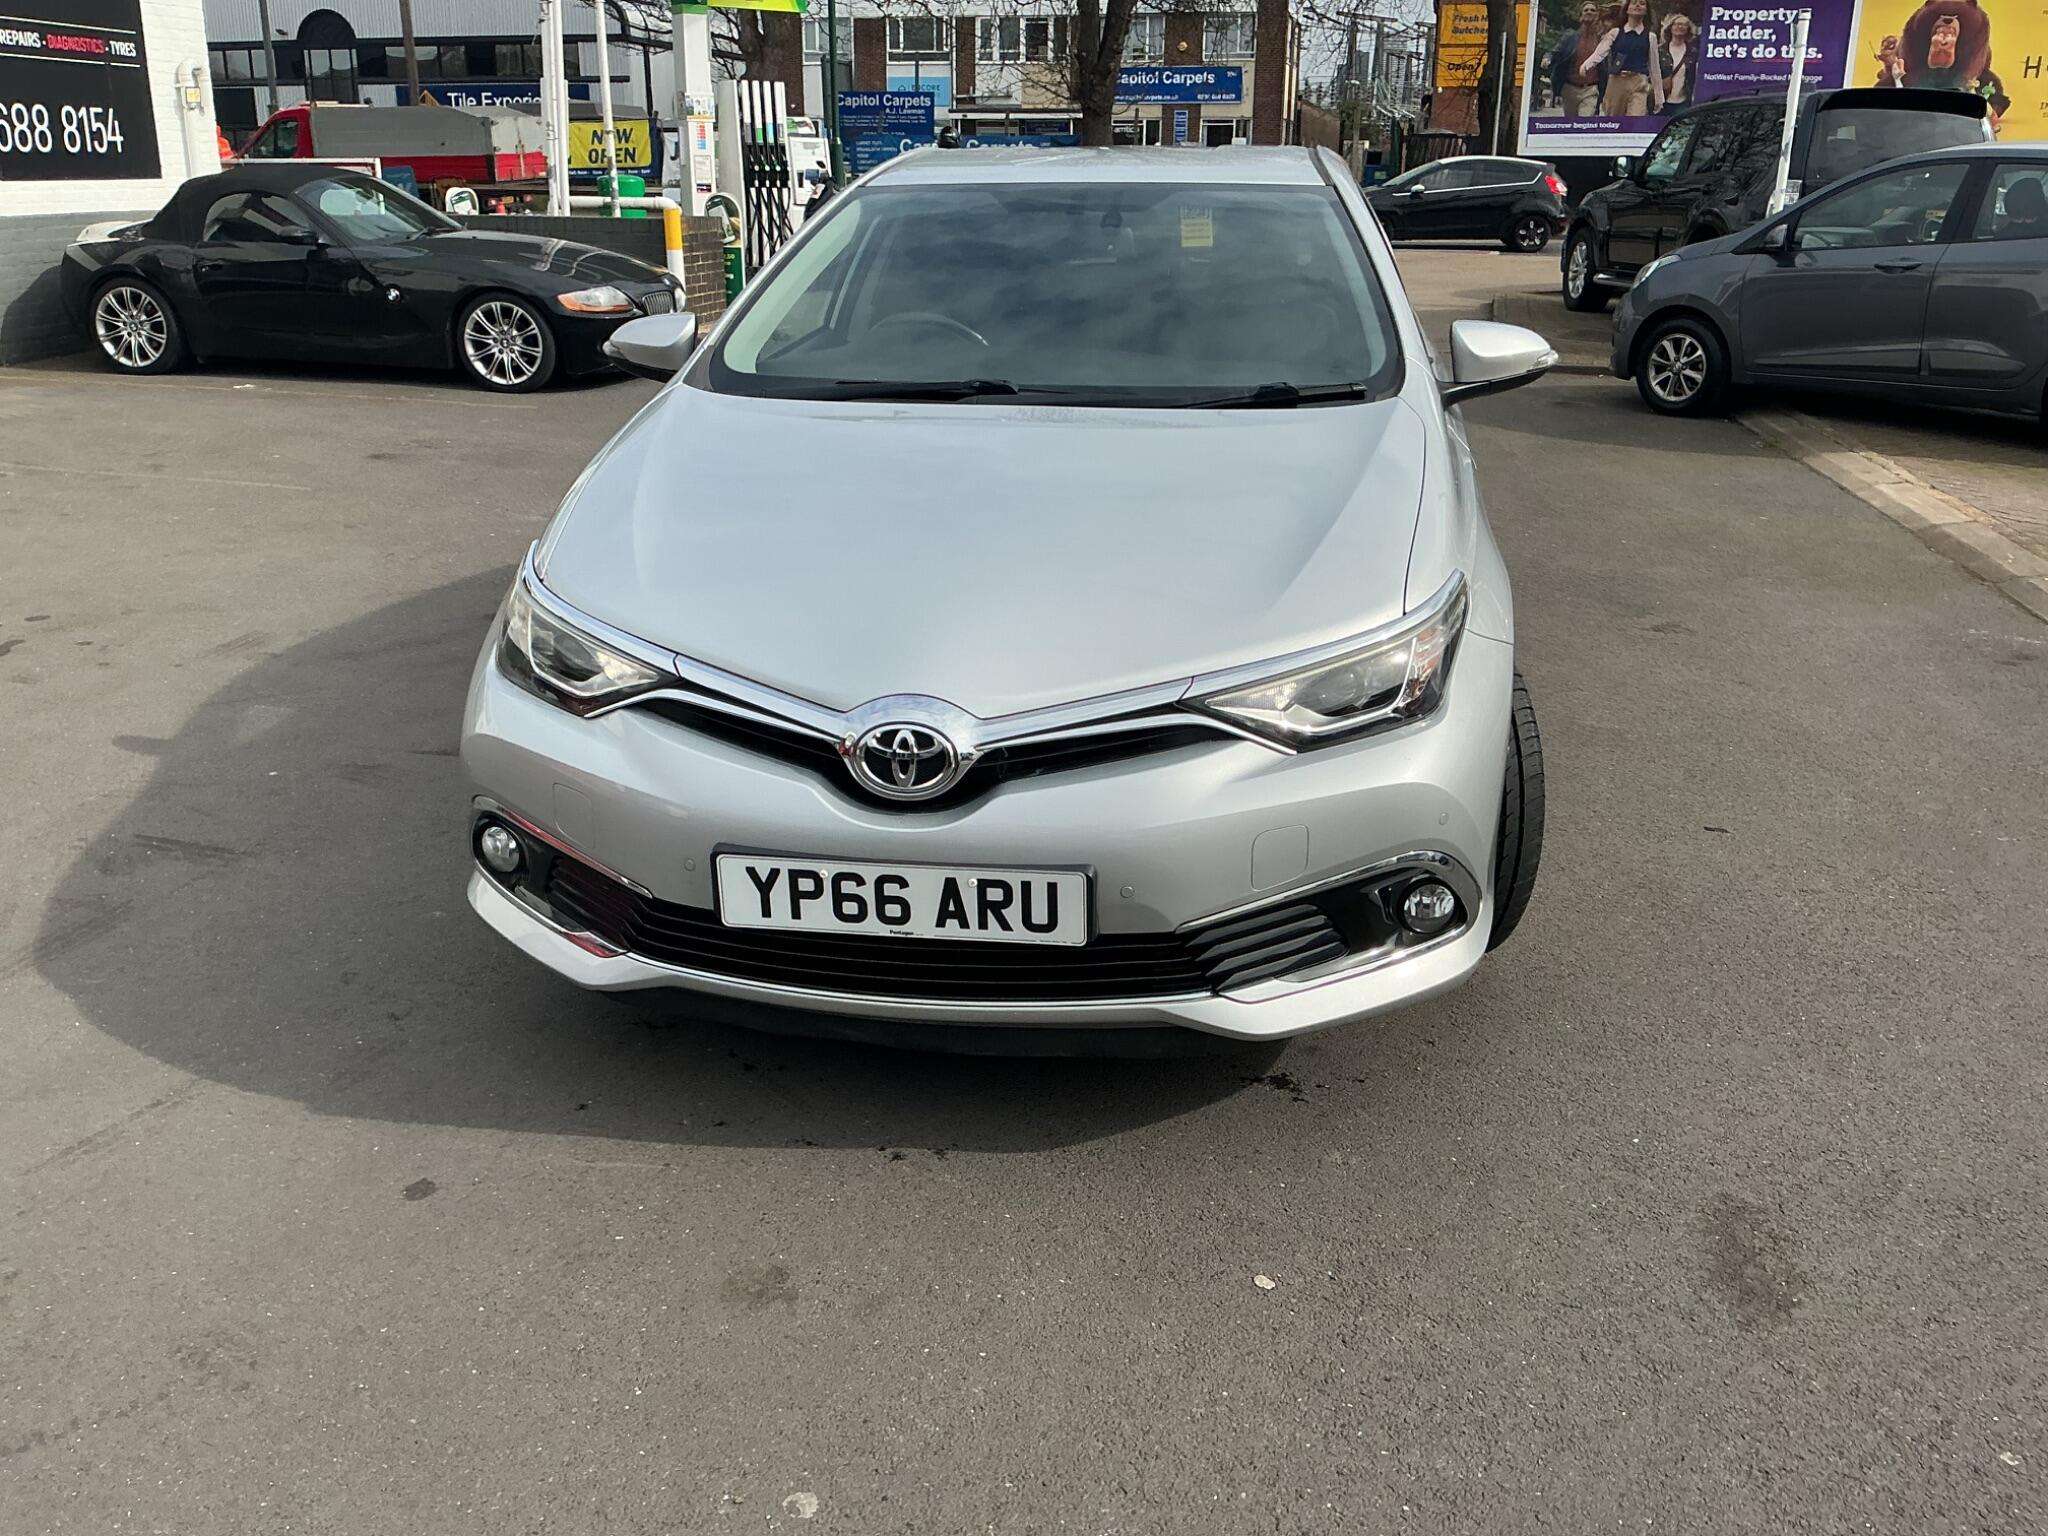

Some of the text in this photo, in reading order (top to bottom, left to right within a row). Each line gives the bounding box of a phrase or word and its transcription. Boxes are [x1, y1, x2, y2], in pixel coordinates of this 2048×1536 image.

[1711, 7, 1798, 24] Property
[1708, 25, 1777, 42] ladder,
[0, 29, 137, 57] REPAIRS DIAGNOSTICS TYRES
[1706, 44, 1823, 59] let's do ths.
[1117, 71, 1159, 85] apitol
[1163, 71, 1215, 86] Carpets
[1704, 73, 1823, 83] NatWest Family-Backed tgage
[447, 92, 542, 108] Tile Experie
[838, 94, 931, 108] Capitol Carpets
[0, 102, 124, 153] 688 8154
[1573, 122, 1598, 130] begins
[591, 128, 633, 145] NW
[745, 866, 1058, 933] YP66 ARU
